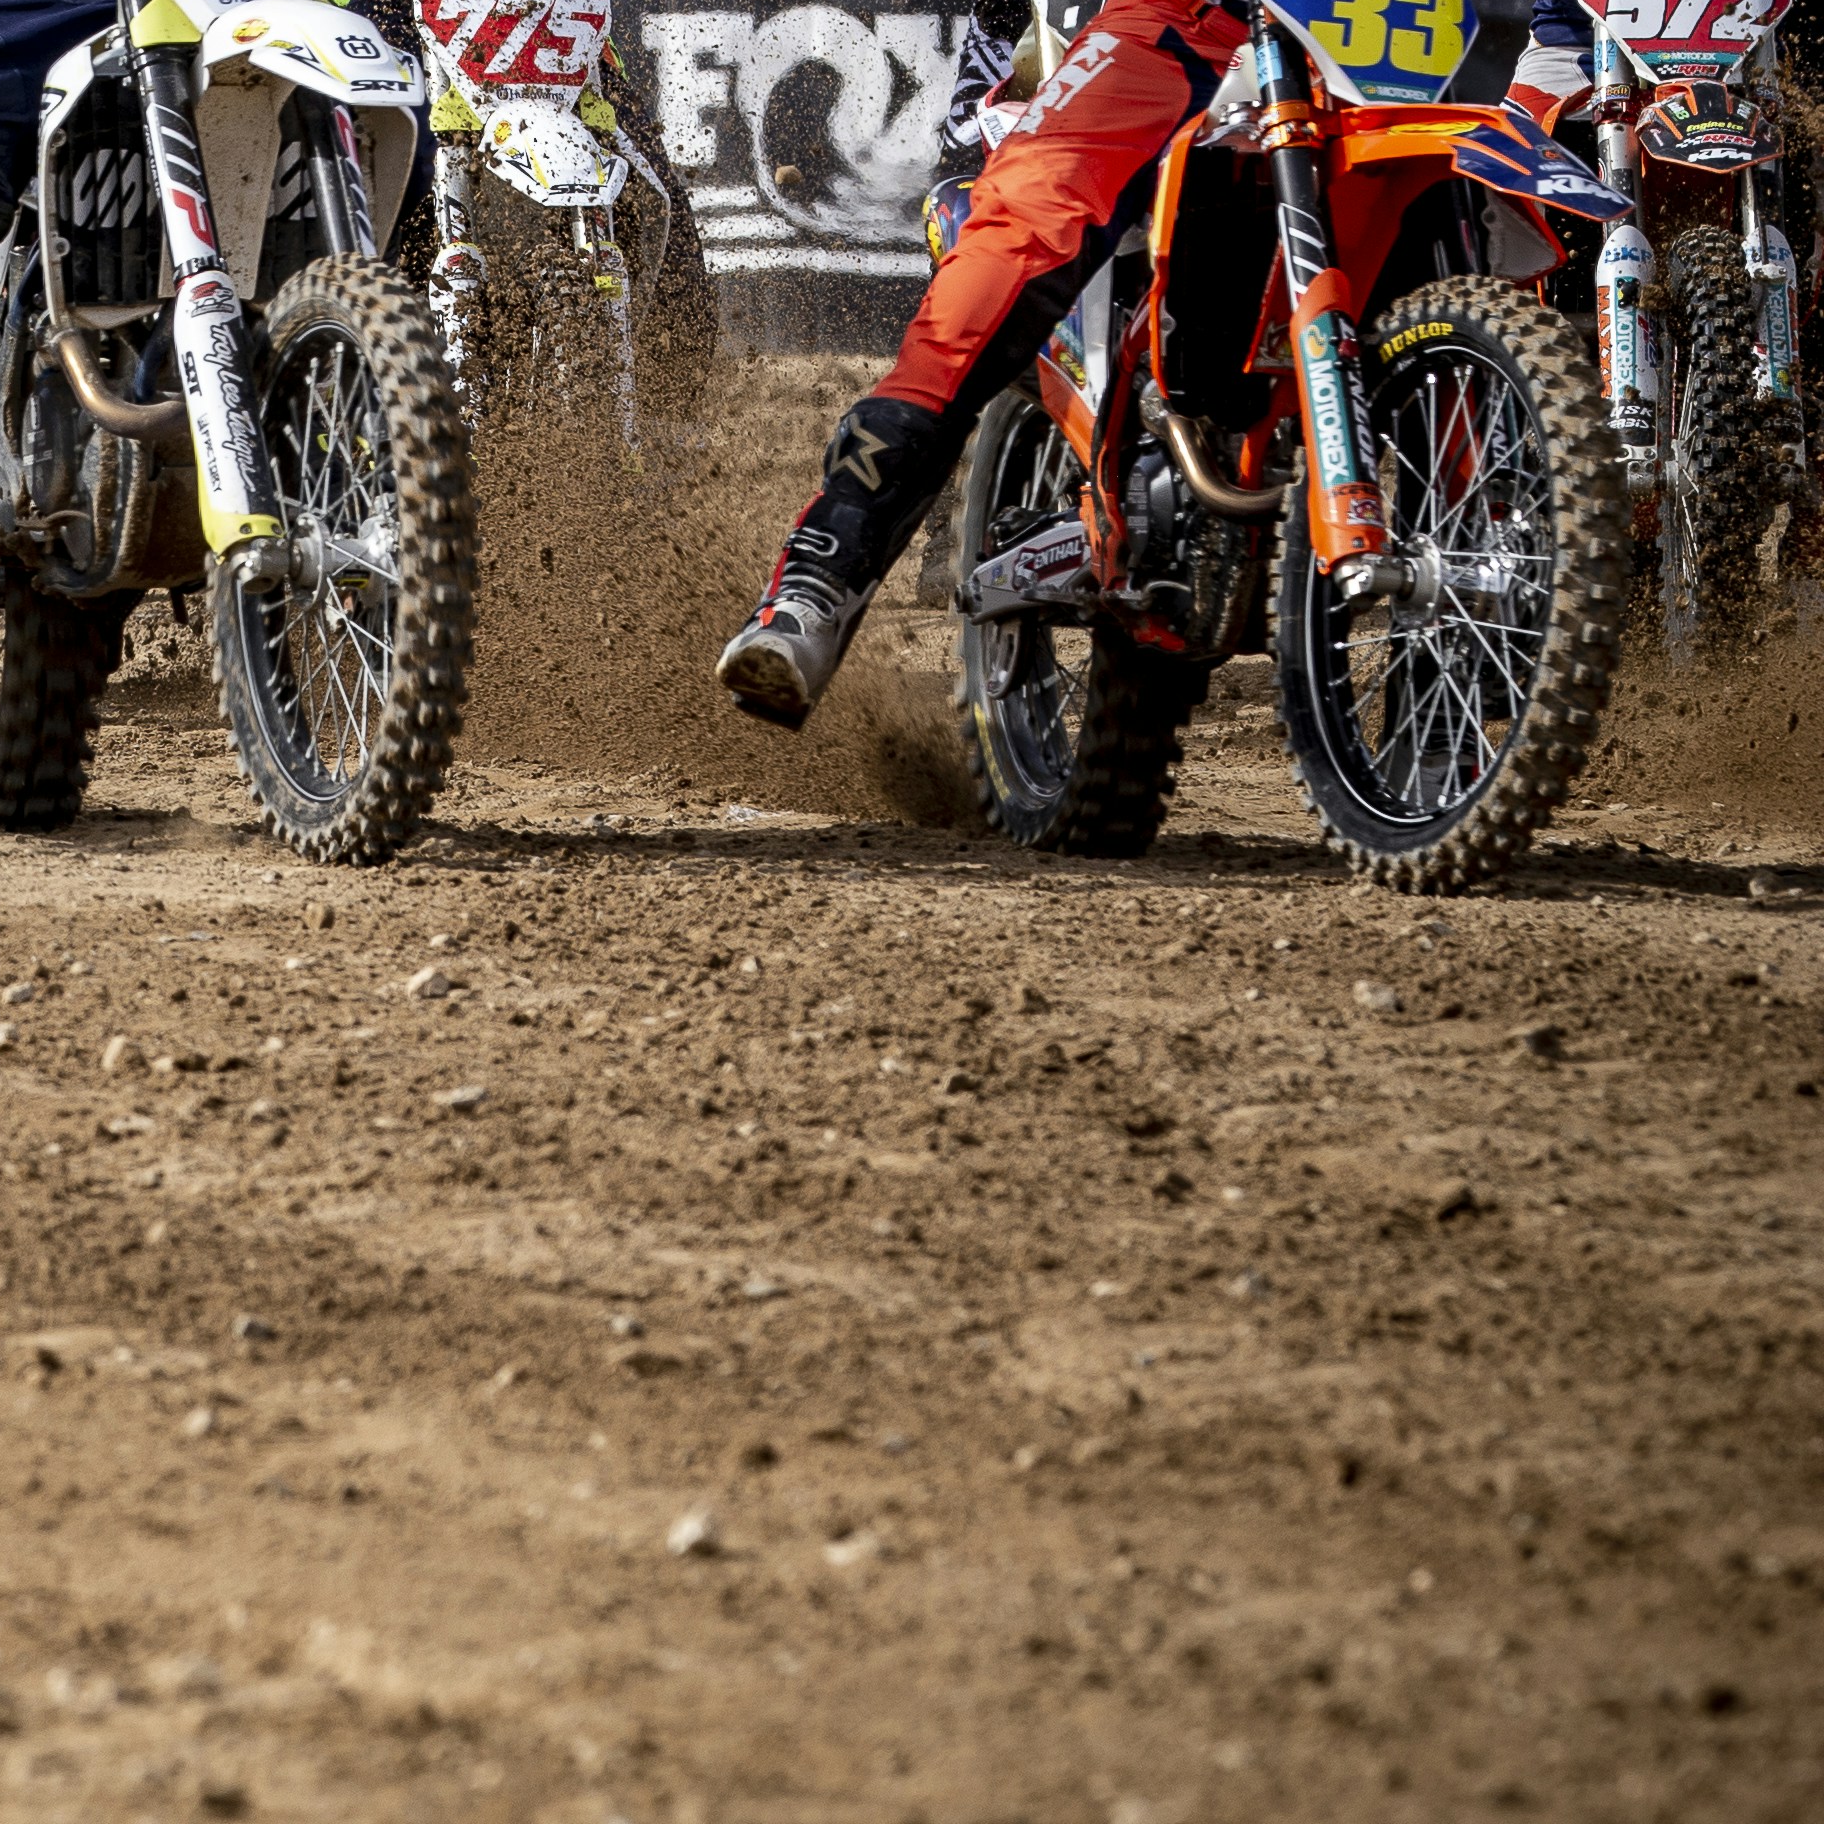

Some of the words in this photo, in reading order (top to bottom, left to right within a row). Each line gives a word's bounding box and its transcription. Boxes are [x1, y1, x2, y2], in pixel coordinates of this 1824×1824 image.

[351, 78, 412, 92] SRT
[641, 5, 974, 231] FOX
[1688, 147, 1753, 163] KTM
[549, 182, 602, 196] SRT
[1536, 173, 1624, 205] KTM
[1381, 322, 1455, 365] DUNLOP
[1616, 307, 1638, 388] MOTOREX
[180, 350, 202, 397] SRT
[1307, 358, 1351, 477] MOTOREX
